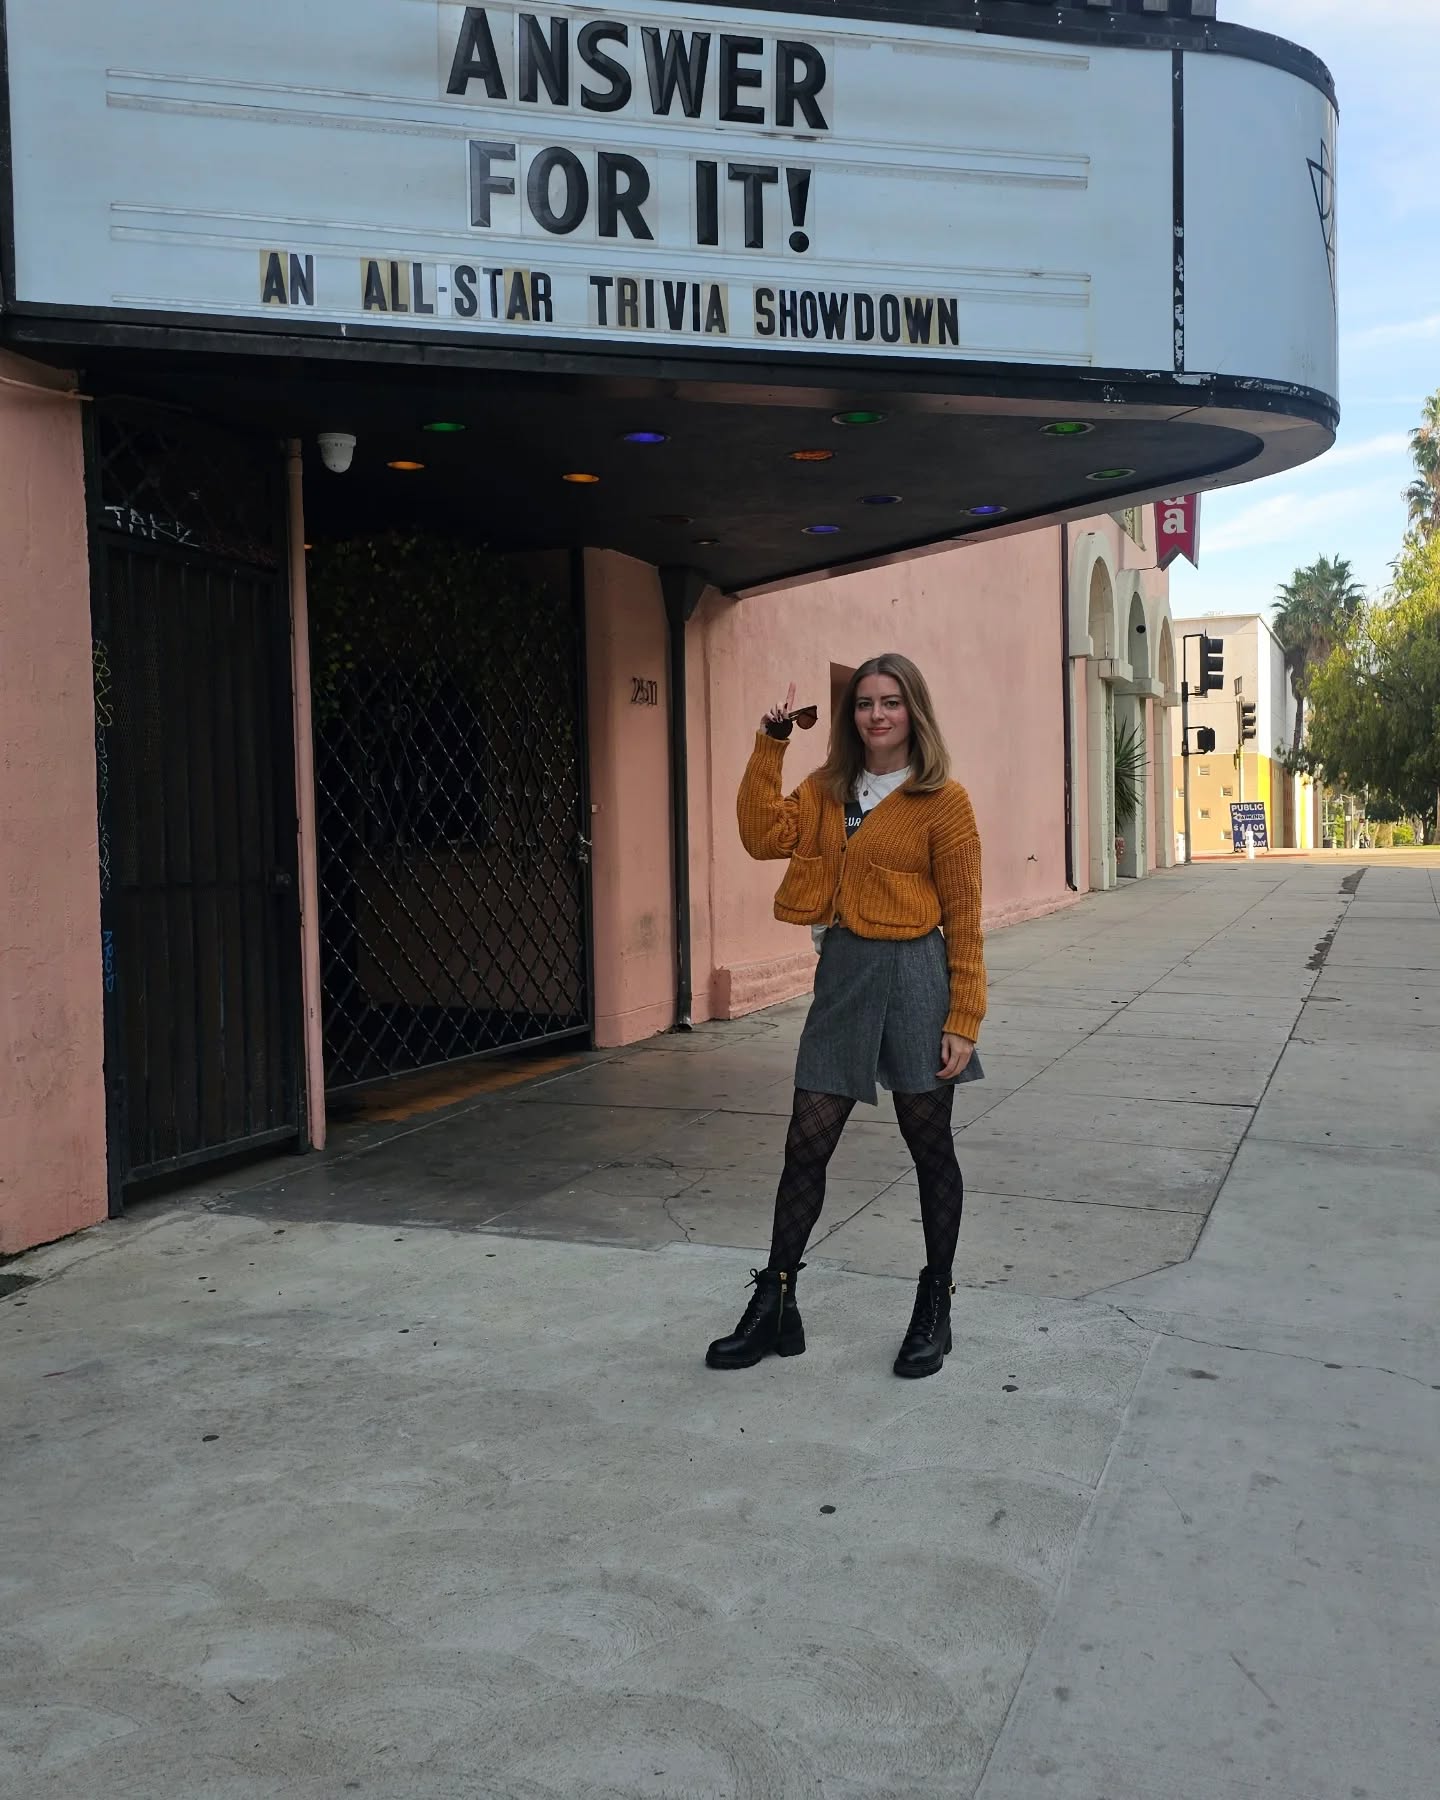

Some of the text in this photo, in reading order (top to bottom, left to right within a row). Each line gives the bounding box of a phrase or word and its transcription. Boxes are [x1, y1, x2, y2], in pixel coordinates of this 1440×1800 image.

[446, 6, 828, 130] ANSWER
[469, 139, 811, 253] FOR IT!
[262, 252, 959, 346] AN ALL-STAR TRIVIA SHOWDOWN
[1231, 803, 1263, 812] PUBLIC
